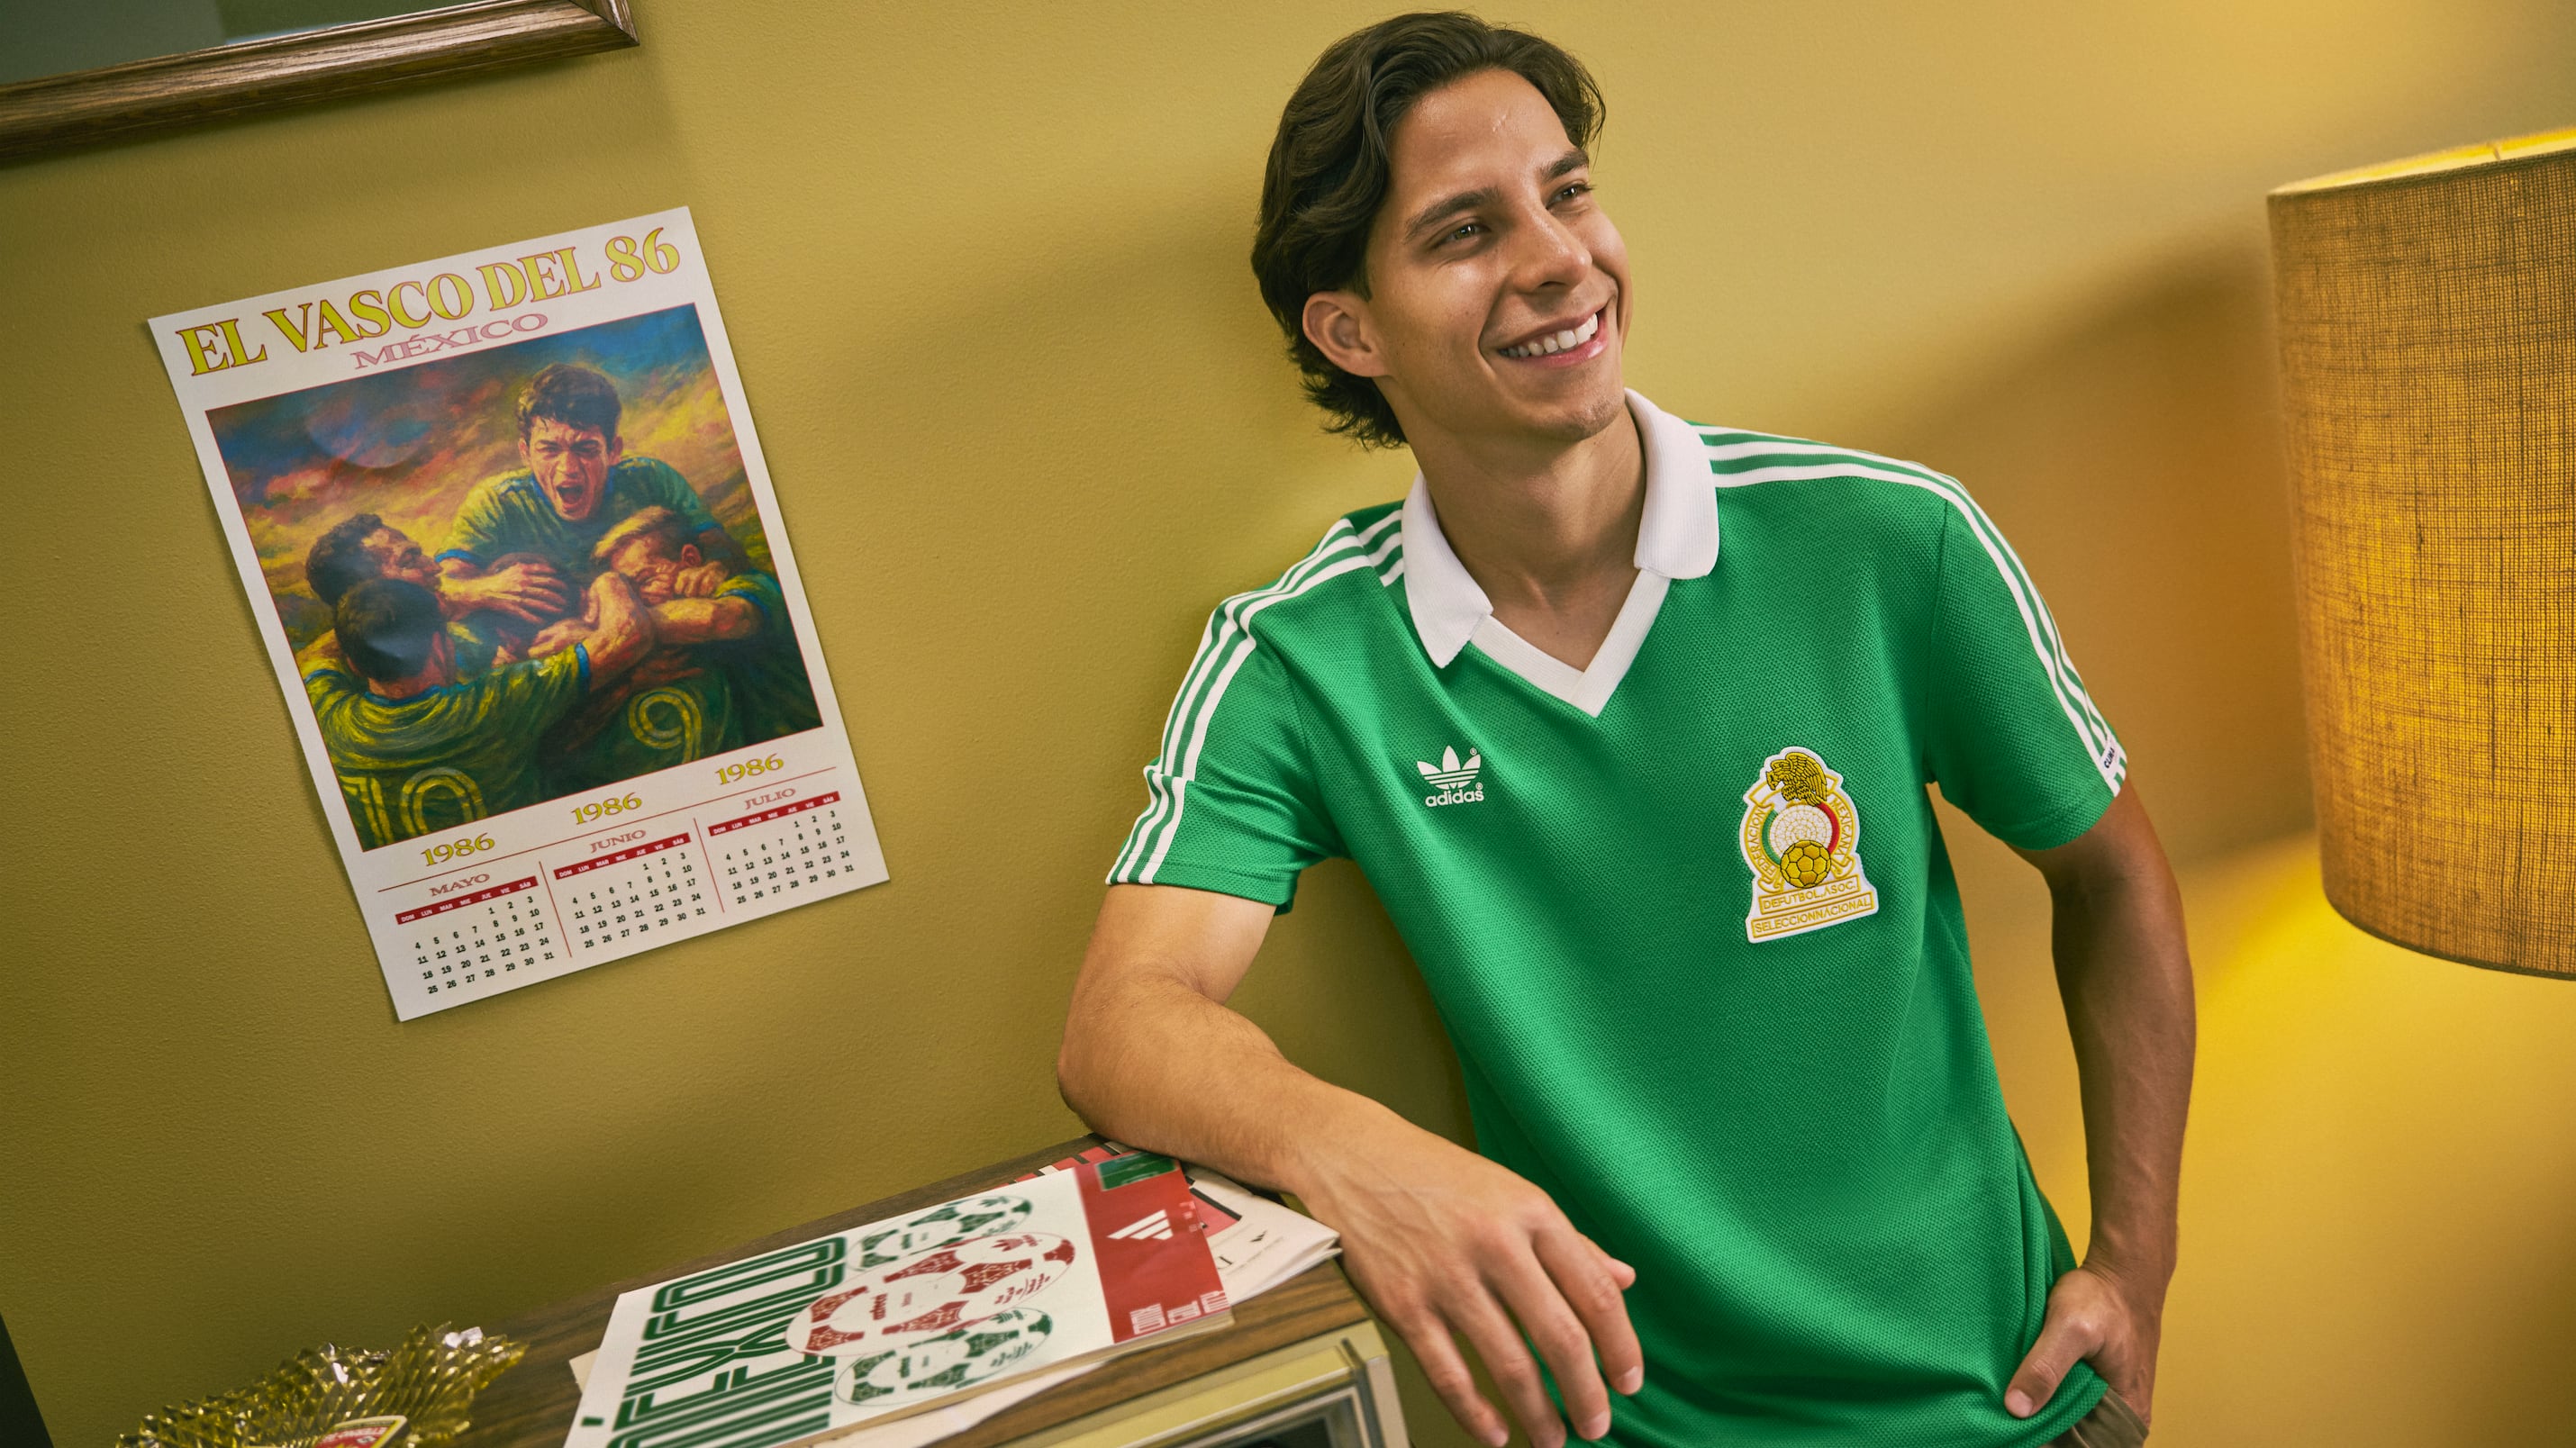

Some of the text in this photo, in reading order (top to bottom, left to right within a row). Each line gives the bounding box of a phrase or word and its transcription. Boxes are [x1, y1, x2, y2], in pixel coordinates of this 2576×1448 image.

[175, 227, 681, 376] EL VASCO DEL 86
[349, 312, 549, 370] MÉXICO
[714, 753, 785, 786] 1986
[571, 792, 643, 827] 1986
[744, 788, 796, 810] JULIO
[1425, 789, 1484, 807] adidas
[812, 815, 817, 823] 2
[420, 832, 496, 866] 1986
[590, 829, 647, 853] JUNIO
[728, 836, 845, 875] 11 12 13 14 15 16 17
[742, 848, 748, 856] 5
[815, 828, 821, 836] 9
[832, 822, 841, 831] 10
[558, 869, 573, 878] DOM
[578, 864, 590, 873] LUN
[595, 859, 610, 867] MAR
[643, 852, 686, 871] 1 2 3
[732, 850, 850, 890] 18 19 20 21 22 23 24
[429, 873, 490, 897] MAYO
[575, 878, 695, 919] 11 12 13 14 15 16 17
[590, 891, 596, 900] 5
[609, 886, 614, 894] 6
[627, 881, 632, 889] 7
[647, 875, 653, 883] 8
[682, 864, 693, 873] 10
[737, 864, 854, 904] 25 26 27 28 29 30 31
[401, 914, 415, 922] DOM
[440, 903, 453, 911] MAR
[488, 907, 495, 915] 1
[507, 901, 514, 910] 2
[579, 892, 701, 934] 18 19 20 21 22 23 24
[417, 921, 544, 965] 11 12 13 14 15 16 17
[433, 937, 440, 945] 5
[453, 931, 459, 939] 6
[472, 926, 477, 934] 7
[493, 919, 499, 928] 8
[512, 914, 518, 922] 9
[530, 908, 540, 918] 10
[584, 907, 706, 948] 25 26 27 28 29 30 31
[422, 937, 549, 980] 18 19 20 21 22 23 24
[427, 952, 555, 994] 25 26 27 28 29 30 31
